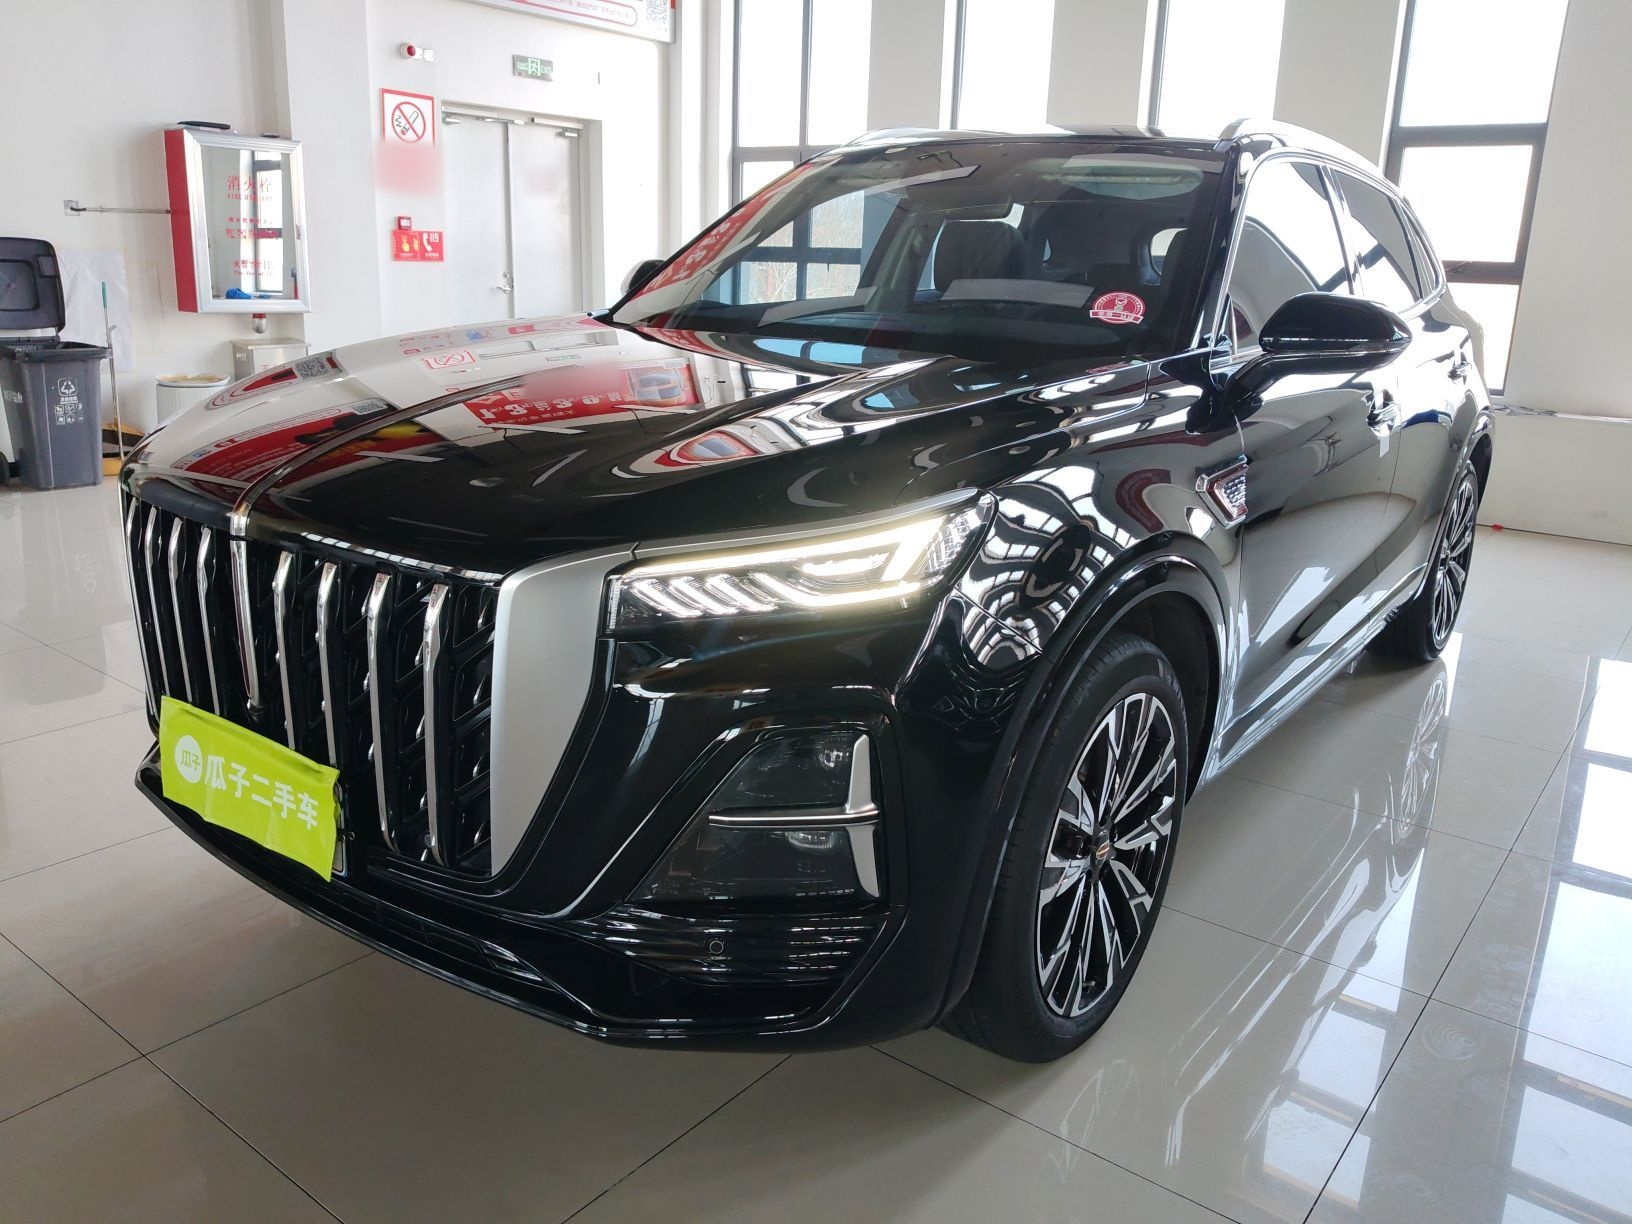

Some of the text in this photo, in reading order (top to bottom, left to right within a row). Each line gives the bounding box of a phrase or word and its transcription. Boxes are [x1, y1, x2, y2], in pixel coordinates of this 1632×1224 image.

[227, 175, 272, 193] 消火栓
[429, 231, 440, 243] 119
[181, 749, 319, 831] 瓜子 瓜子二手车
